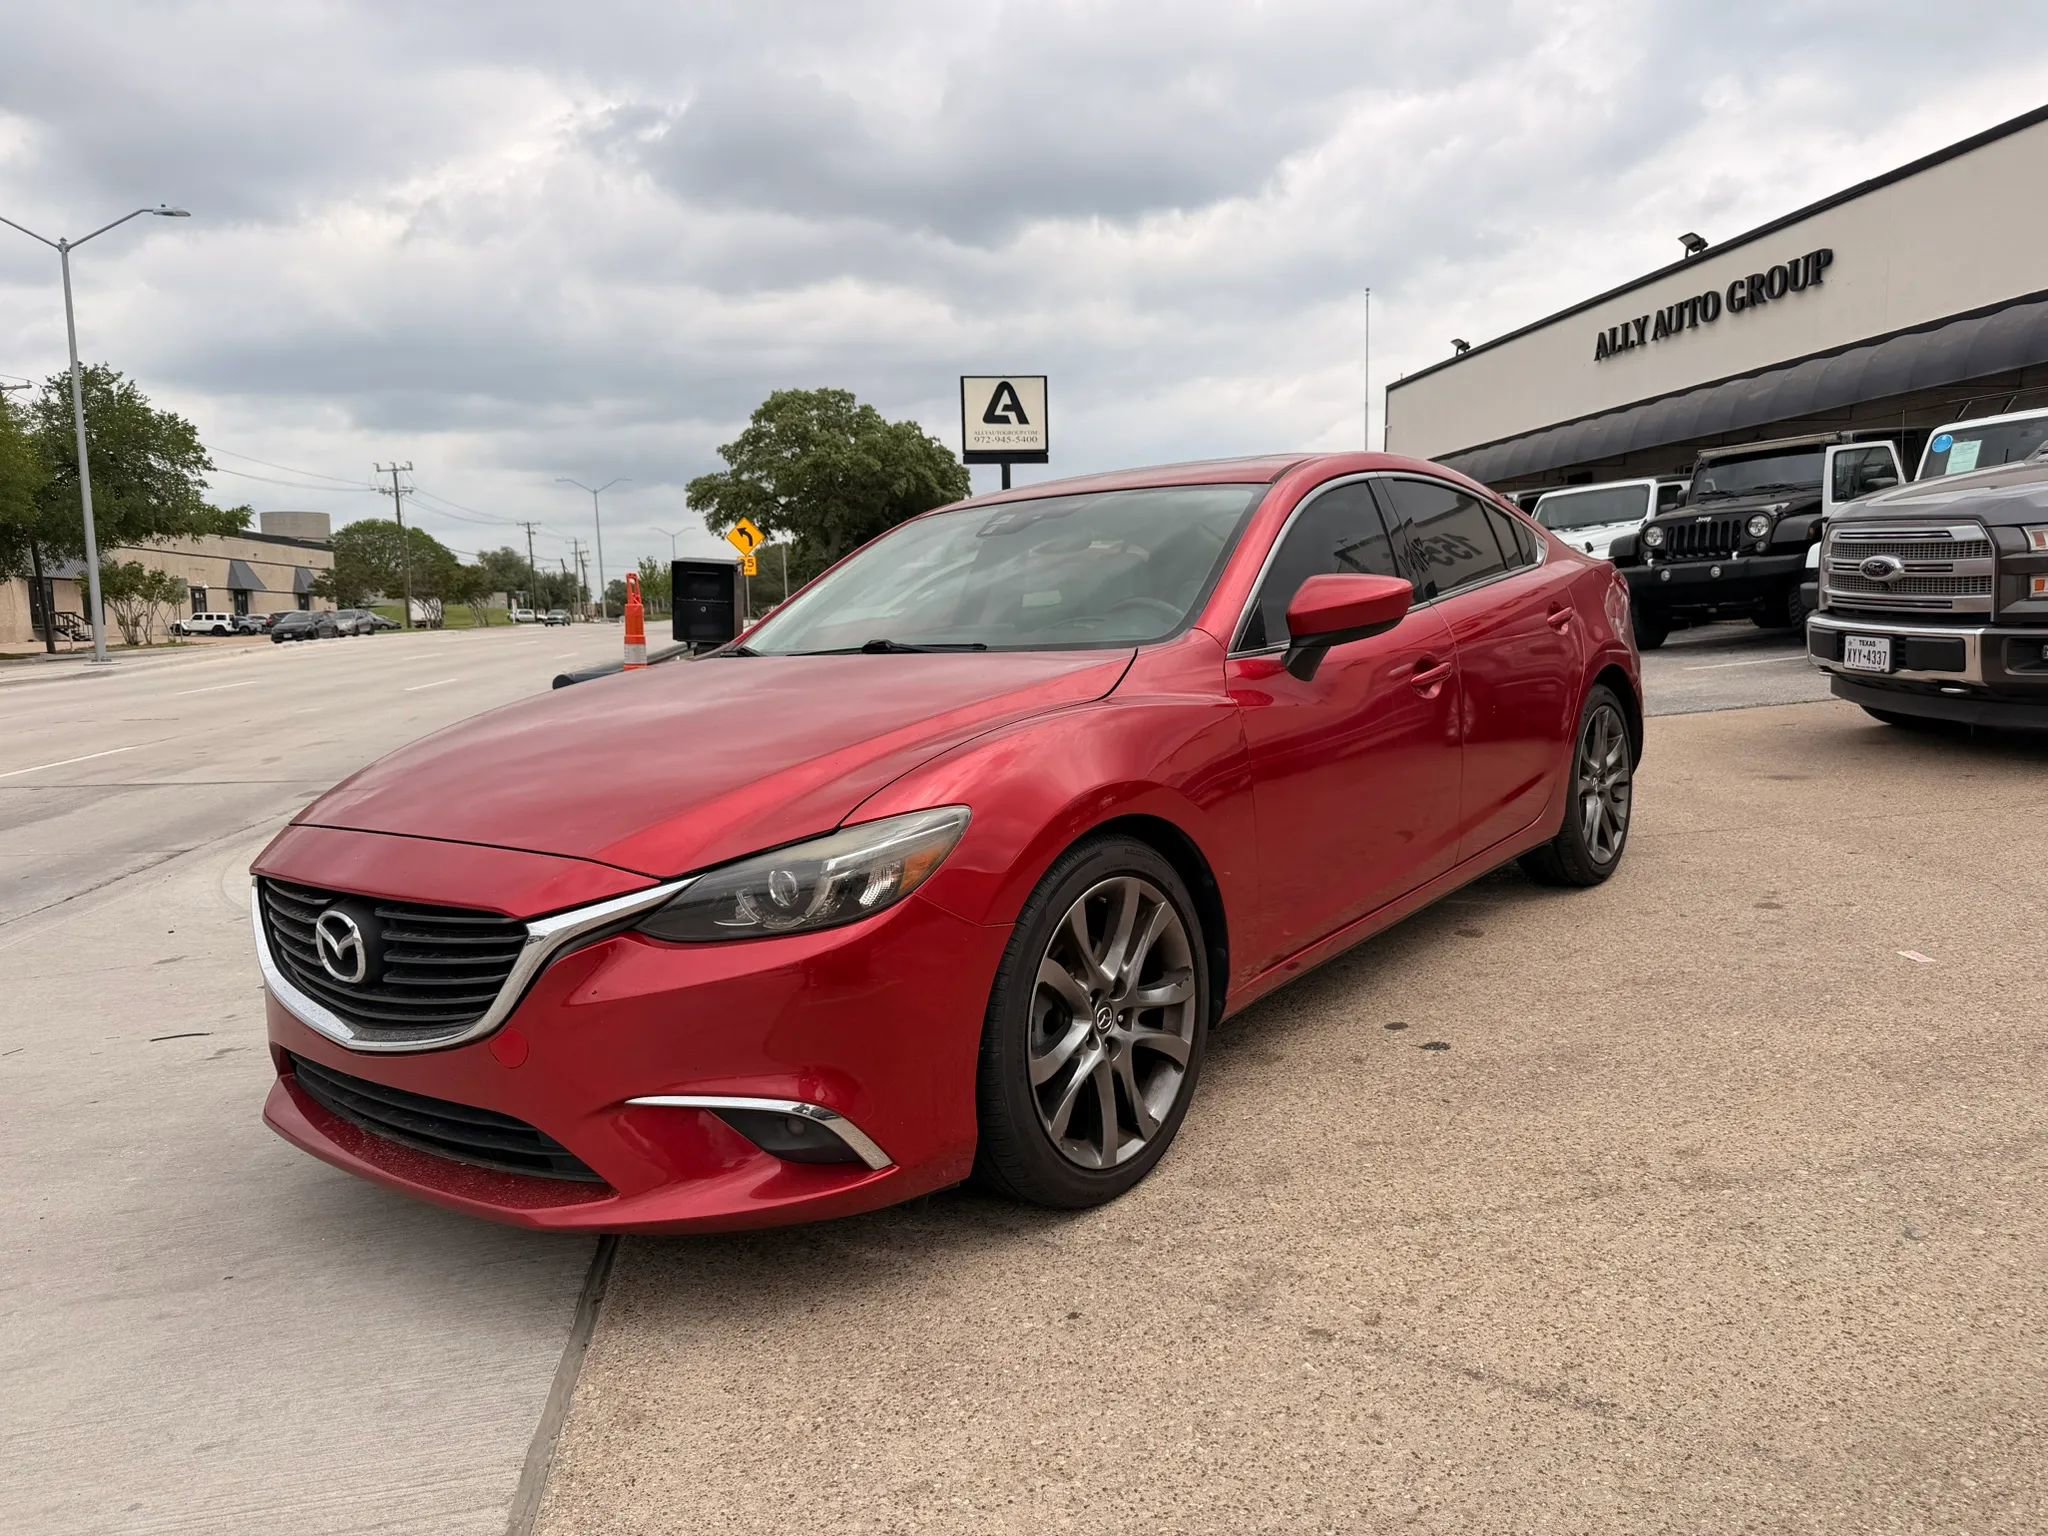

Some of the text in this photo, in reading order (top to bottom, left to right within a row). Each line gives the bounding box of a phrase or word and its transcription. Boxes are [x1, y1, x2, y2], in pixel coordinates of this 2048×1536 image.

[1594, 248, 1833, 361] ALLY AUTO GROUP
[1859, 639, 1876, 647] TEXAS
